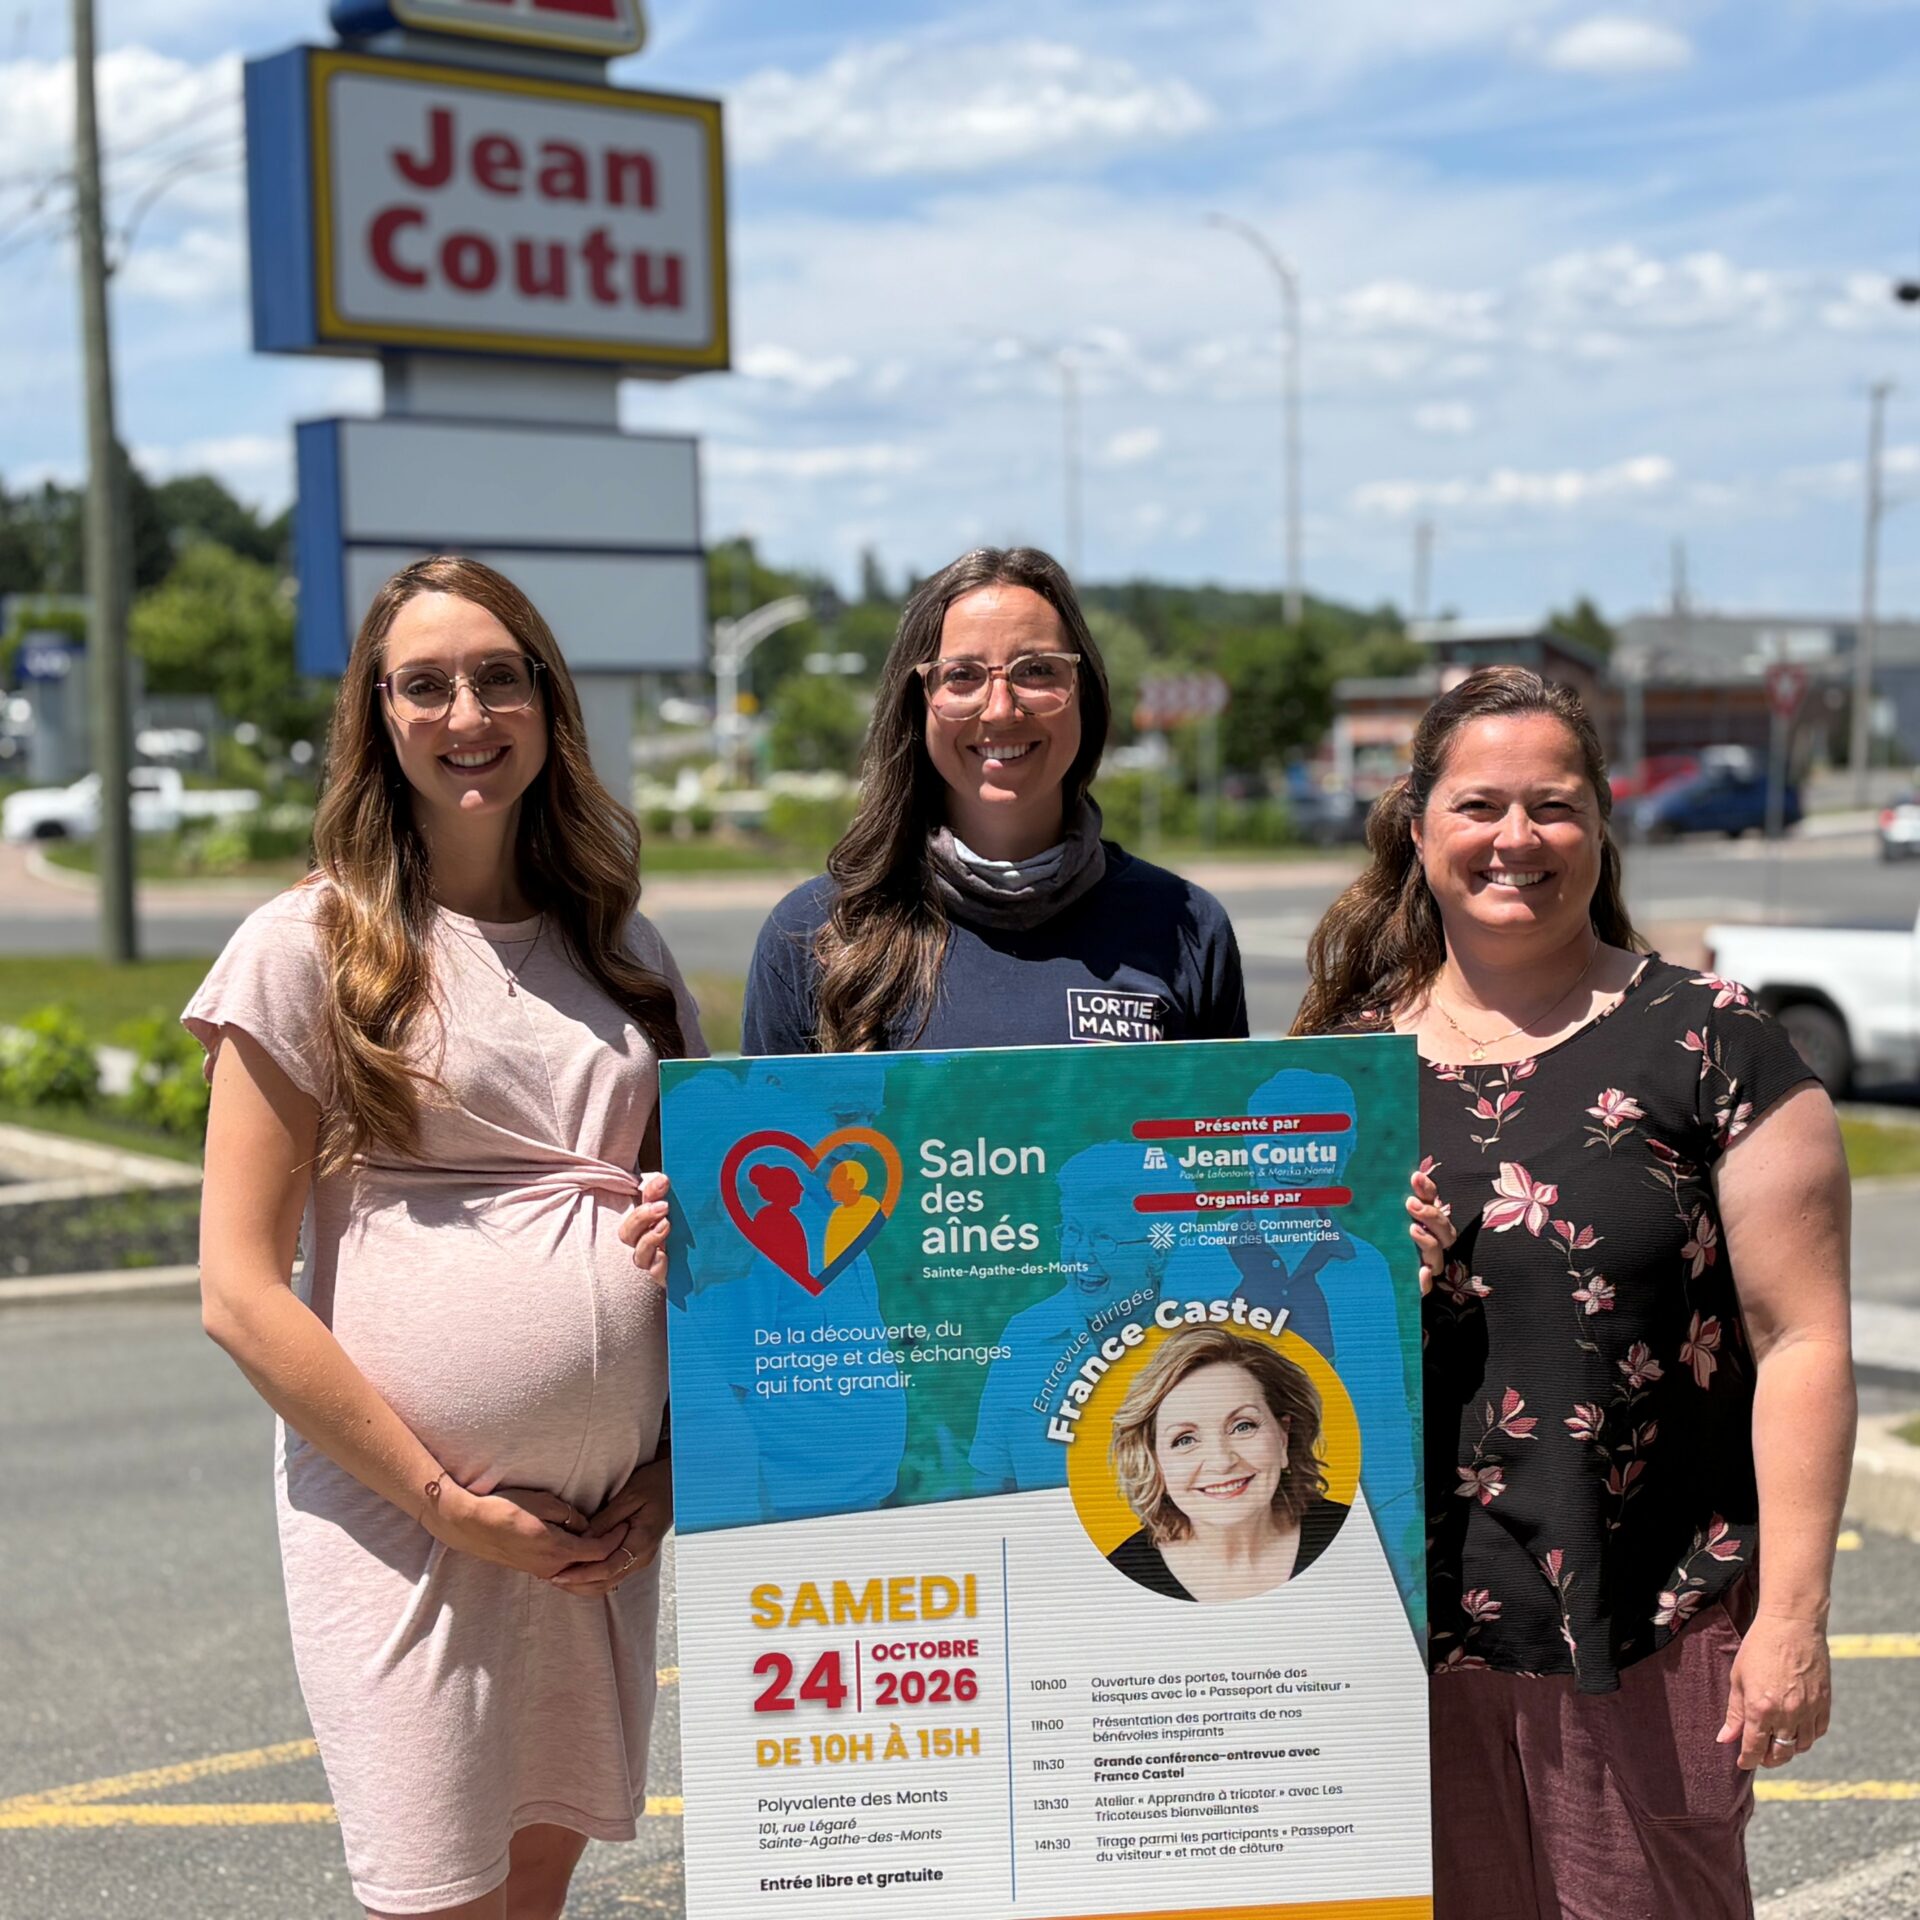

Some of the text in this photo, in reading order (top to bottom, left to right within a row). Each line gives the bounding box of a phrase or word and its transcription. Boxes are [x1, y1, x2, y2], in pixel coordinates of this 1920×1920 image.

[391, 106, 658, 211] Jean
[367, 204, 685, 311] Coutu
[1077, 995, 1153, 1019] LORTIE
[1078, 1016, 1164, 1042] MARTIN
[1195, 1117, 1301, 1134] Présenté par
[919, 1137, 1046, 1178] Salon
[921, 1183, 984, 1214] des
[1195, 1190, 1302, 1208] Organisé par
[922, 1214, 1040, 1255] aînés
[1179, 1219, 1332, 1234] Chambre de Commerce
[1179, 1230, 1340, 1246] du Coeur des Laurentides
[922, 1262, 1089, 1279] Sainte-Agathe-des-Monts
[754, 1320, 962, 1346] De la découverte, du
[755, 1344, 1012, 1375] partage et des échanges
[1033, 1288, 1154, 1414] Entrevue dirigée
[1046, 1297, 1290, 1444] France Castel
[756, 1371, 916, 1399] qui font grandir.
[750, 1573, 978, 1630] SAMEDI
[871, 1639, 979, 1662] OCTOBRE
[753, 1650, 848, 1712] 24
[875, 1668, 978, 1706] 2026
[1030, 1679, 1067, 1691] 10h00
[1091, 1668, 1308, 1688] Ouverture des portes, tournée des
[1091, 1692, 1148, 1704] kiosques
[1150, 1689, 1182, 1700] avec
[1185, 1688, 1197, 1698] le
[1209, 1684, 1273, 1698] Passeport
[1276, 1683, 1293, 1694] du
[1295, 1681, 1341, 1693] visiteur
[1031, 1719, 1064, 1731] 11h00
[1092, 1708, 1302, 1728] Présentation des portraits de nos
[756, 1722, 981, 1768] DE 10H À 15H
[1093, 1727, 1225, 1742] bénévoles inspirants
[1032, 1758, 1065, 1771] 11h30
[1094, 1755, 1143, 1767] Grande
[1288, 1747, 1320, 1758] avec
[1094, 1768, 1185, 1783] France Castel
[758, 1789, 949, 1815] Polyvalente des Monts
[1033, 1798, 1069, 1811] 13h30
[1094, 1795, 1135, 1807] Atelier
[1147, 1791, 1215, 1806] Apprendre
[1218, 1789, 1227, 1801] à
[1230, 1788, 1276, 1800] tricoter
[1288, 1786, 1320, 1797] avec
[1322, 1784, 1343, 1795] Les
[1095, 1804, 1259, 1822] Tricoteuses bienveillantes
[758, 1817, 857, 1835] 101, rue Légaré
[1096, 1836, 1136, 1849] Tirage
[1139, 1832, 1178, 1847] parmi
[1181, 1832, 1199, 1842] les
[1201, 1827, 1279, 1843] participants
[1291, 1823, 1355, 1837] Passeport
[758, 1828, 943, 1850] Sainte-Agathe-des-Monts
[1034, 1838, 1071, 1850] 14h30
[1096, 1851, 1113, 1862] du
[1116, 1849, 1162, 1861] visiteur
[1174, 1847, 1187, 1858] et
[1190, 1845, 1217, 1857] mot
[1219, 1844, 1236, 1855] de
[1239, 1842, 1284, 1855] clôture
[760, 1868, 944, 1892] Entrée libre et gratuite
